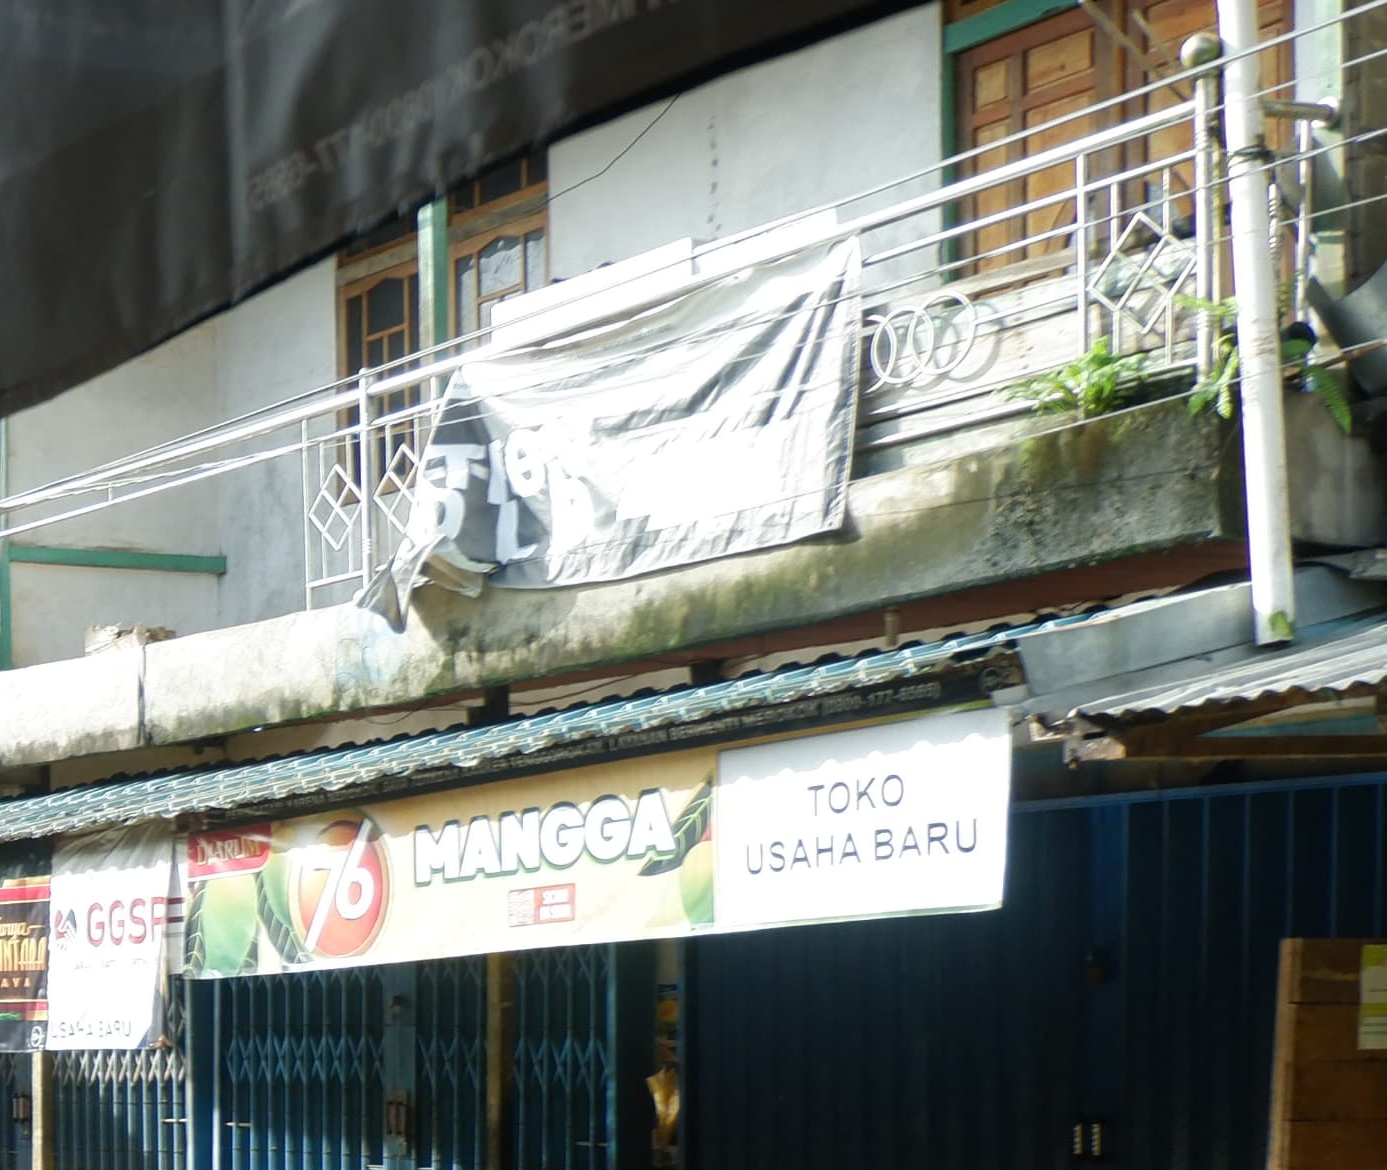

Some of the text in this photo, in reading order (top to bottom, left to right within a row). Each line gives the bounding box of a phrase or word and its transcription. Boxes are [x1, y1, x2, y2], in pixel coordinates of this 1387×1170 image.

[807, 774, 904, 816] TOKO
[413, 788, 676, 887] MANGGA
[746, 818, 977, 875] USAHA BARU
[297, 818, 375, 952] 76
